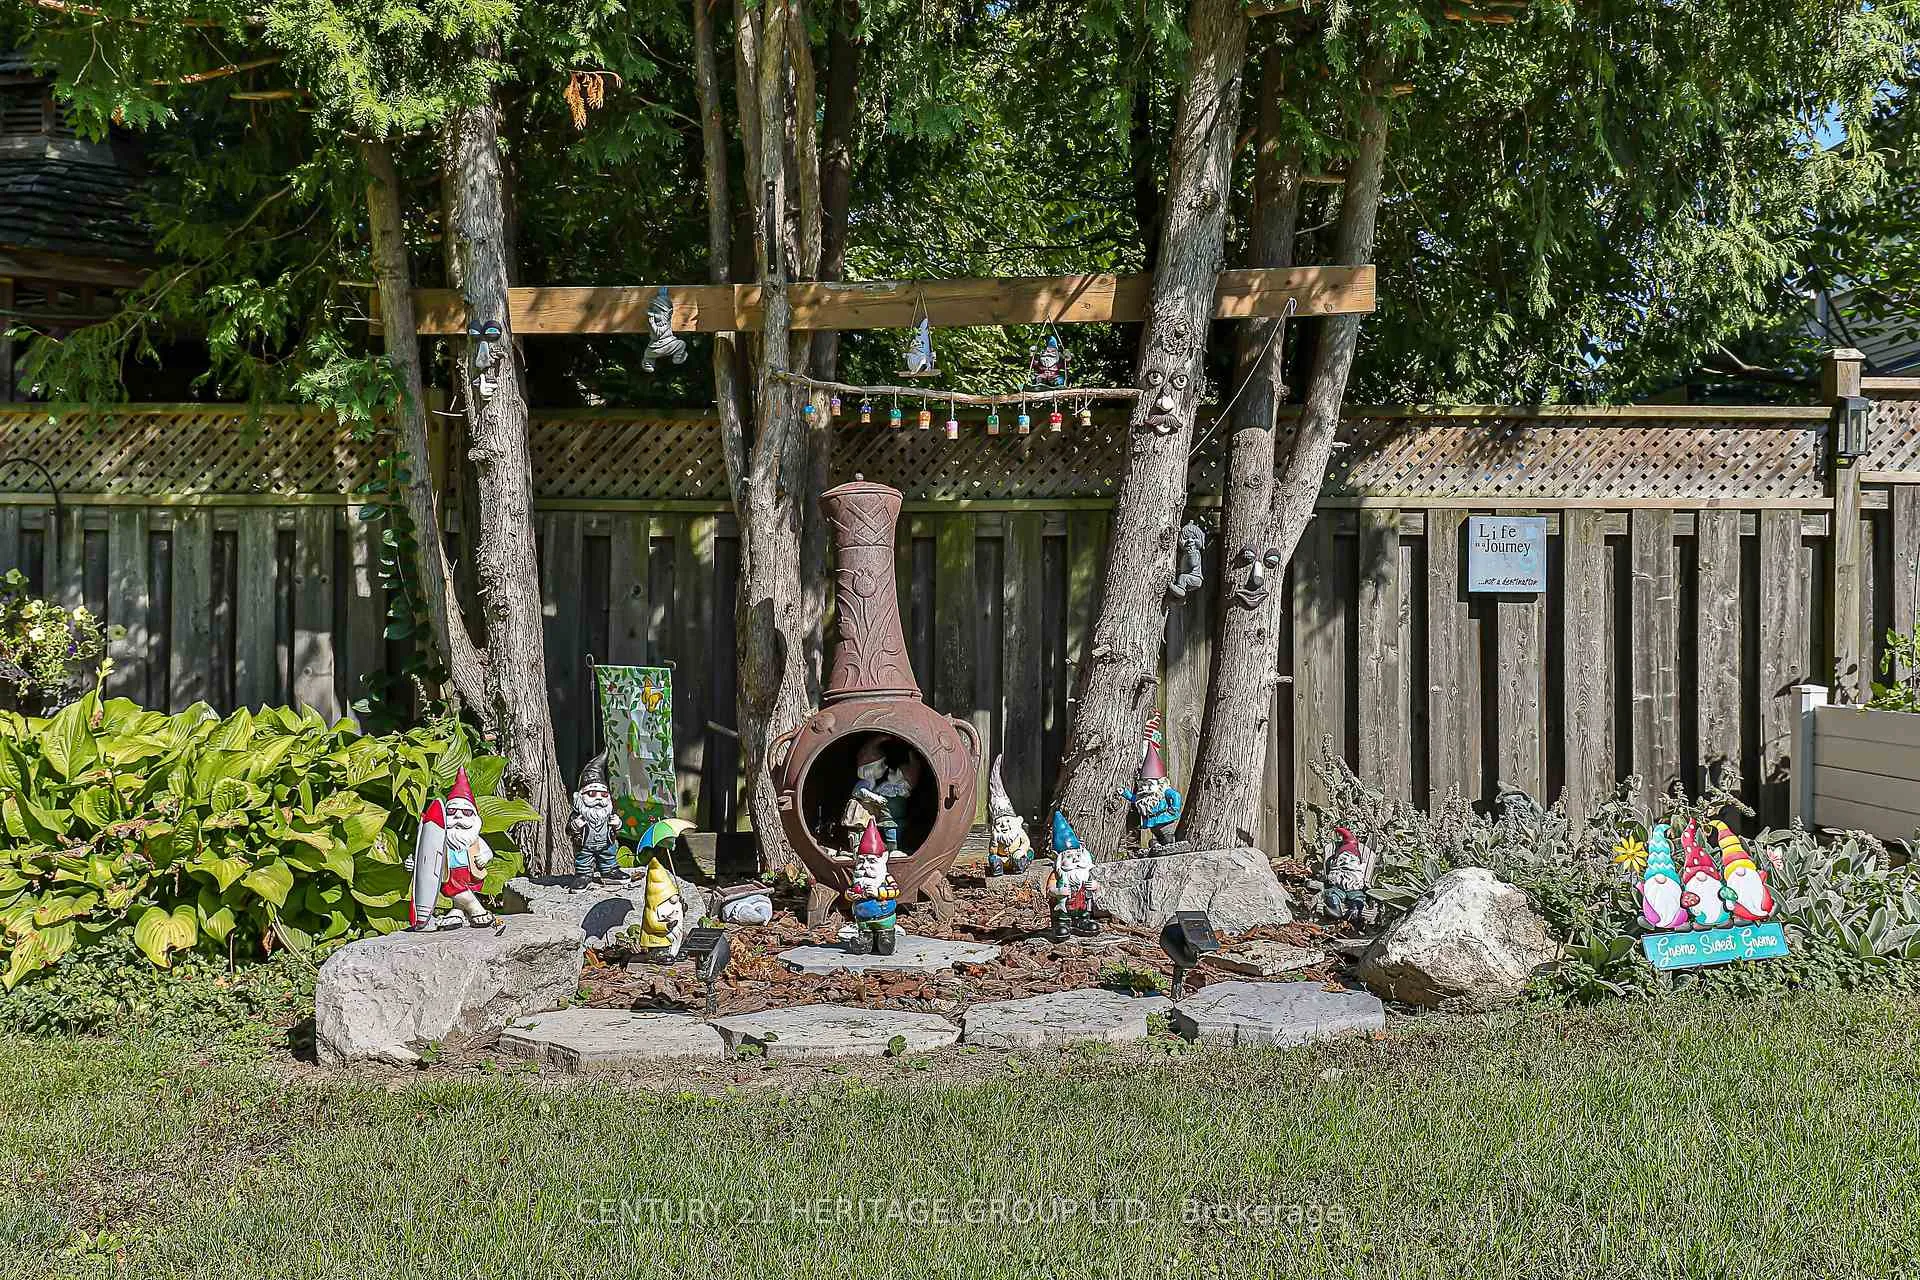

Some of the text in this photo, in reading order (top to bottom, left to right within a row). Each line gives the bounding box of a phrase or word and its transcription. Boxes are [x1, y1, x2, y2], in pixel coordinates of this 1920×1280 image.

[1479, 523, 1516, 540] Life
[1485, 538, 1531, 557] Journey
[1656, 927, 1778, 967] Gnome Sweet Gnome
